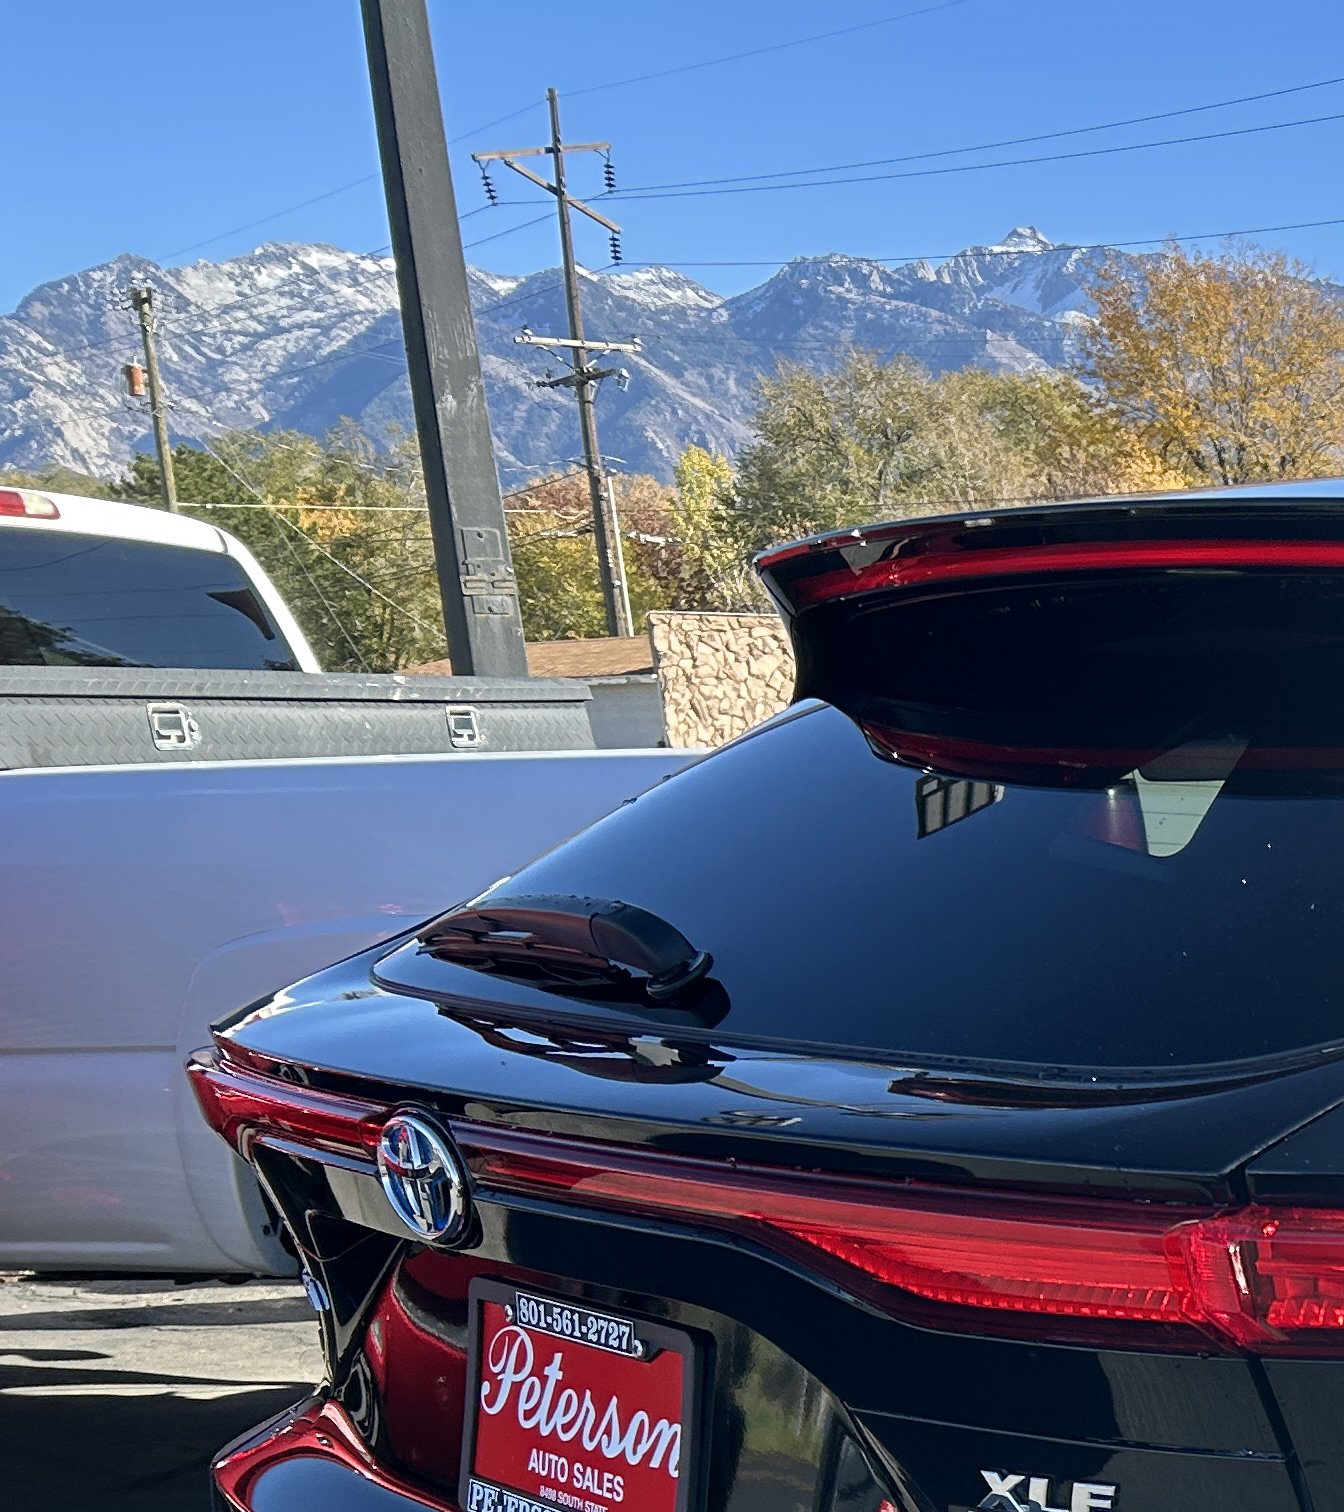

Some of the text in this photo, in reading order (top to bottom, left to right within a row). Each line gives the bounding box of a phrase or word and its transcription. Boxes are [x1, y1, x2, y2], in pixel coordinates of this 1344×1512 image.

[518, 1297, 631, 1351] 801-561-2727
[480, 1325, 682, 1478] Peterson
[528, 1448, 625, 1501] AUTO SALES
[557, 1491, 584, 1512] SOUTH
